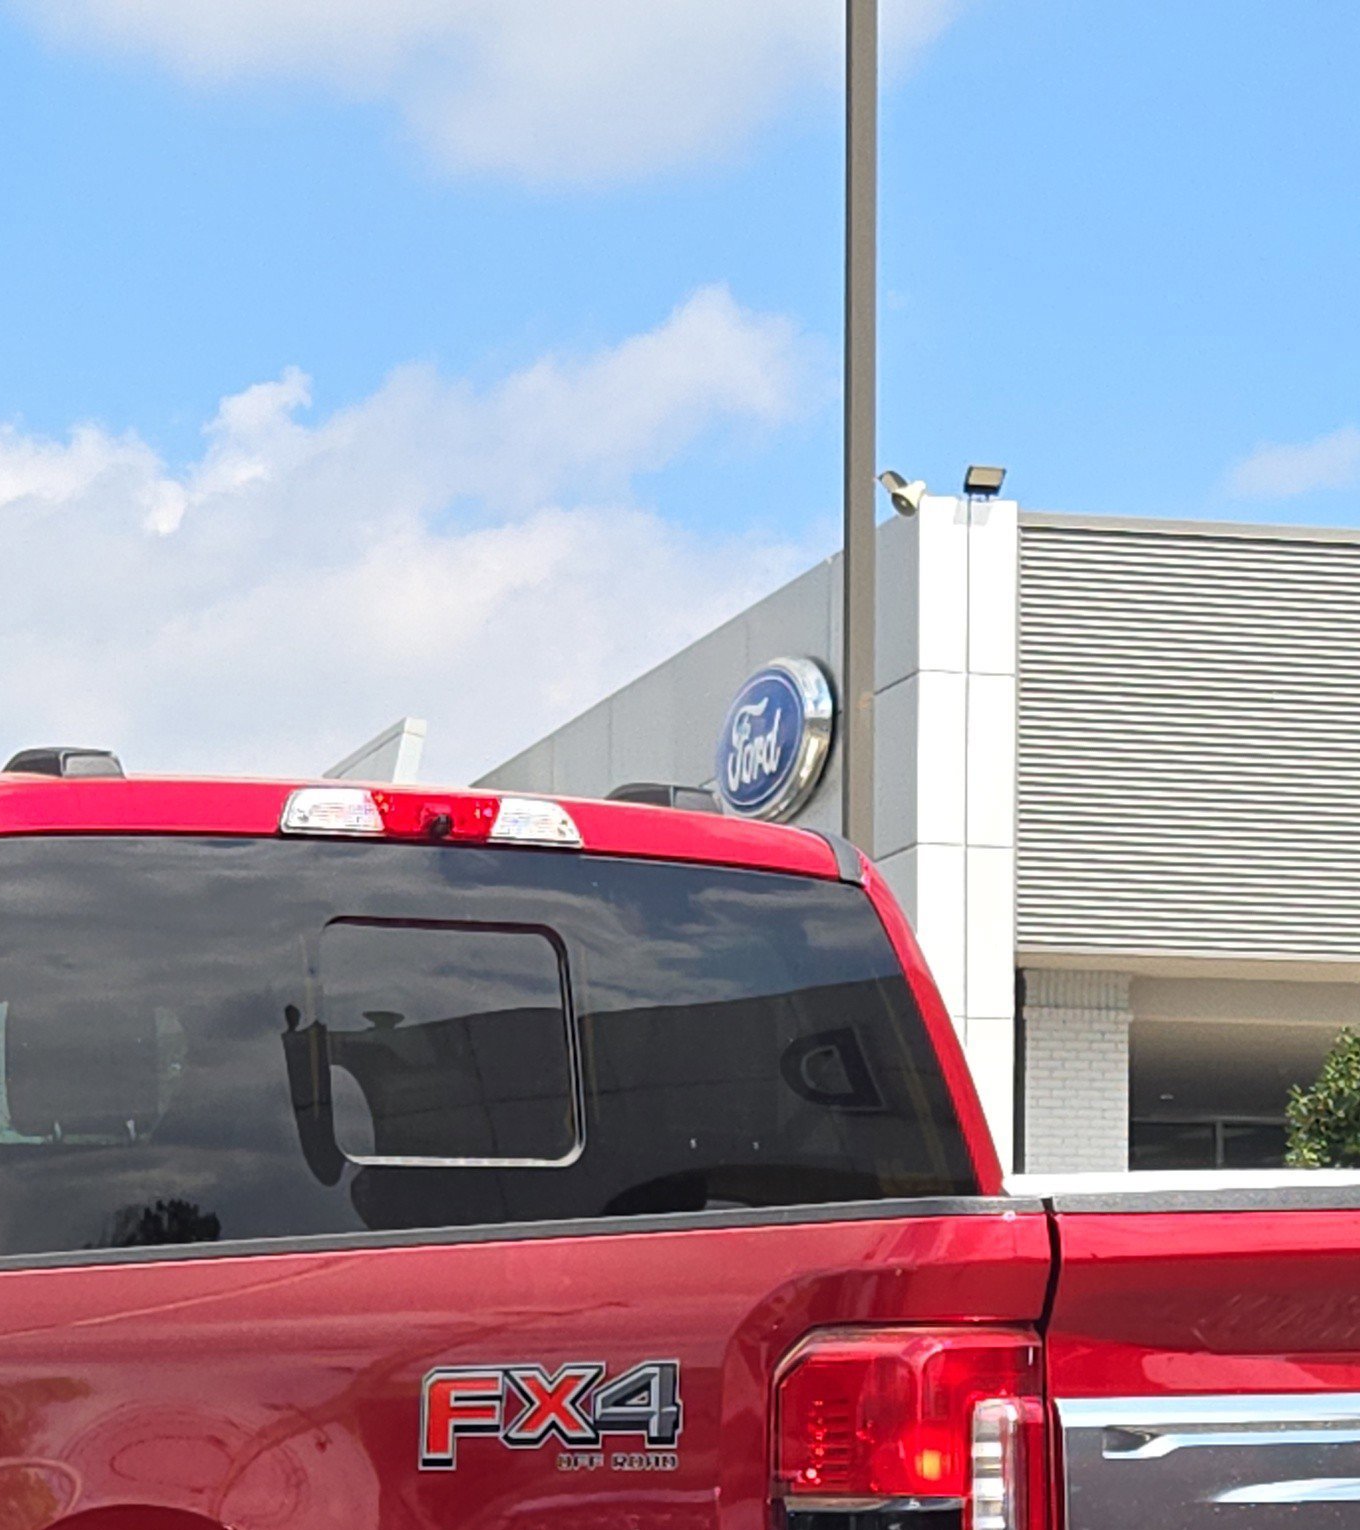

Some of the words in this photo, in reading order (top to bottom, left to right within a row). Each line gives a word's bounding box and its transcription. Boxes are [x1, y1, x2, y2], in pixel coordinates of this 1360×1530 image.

[727, 697, 781, 791] Ford
[418, 1359, 682, 1471] FX4
[557, 1453, 603, 1471] OFF
[612, 1453, 678, 1471] ROAD
